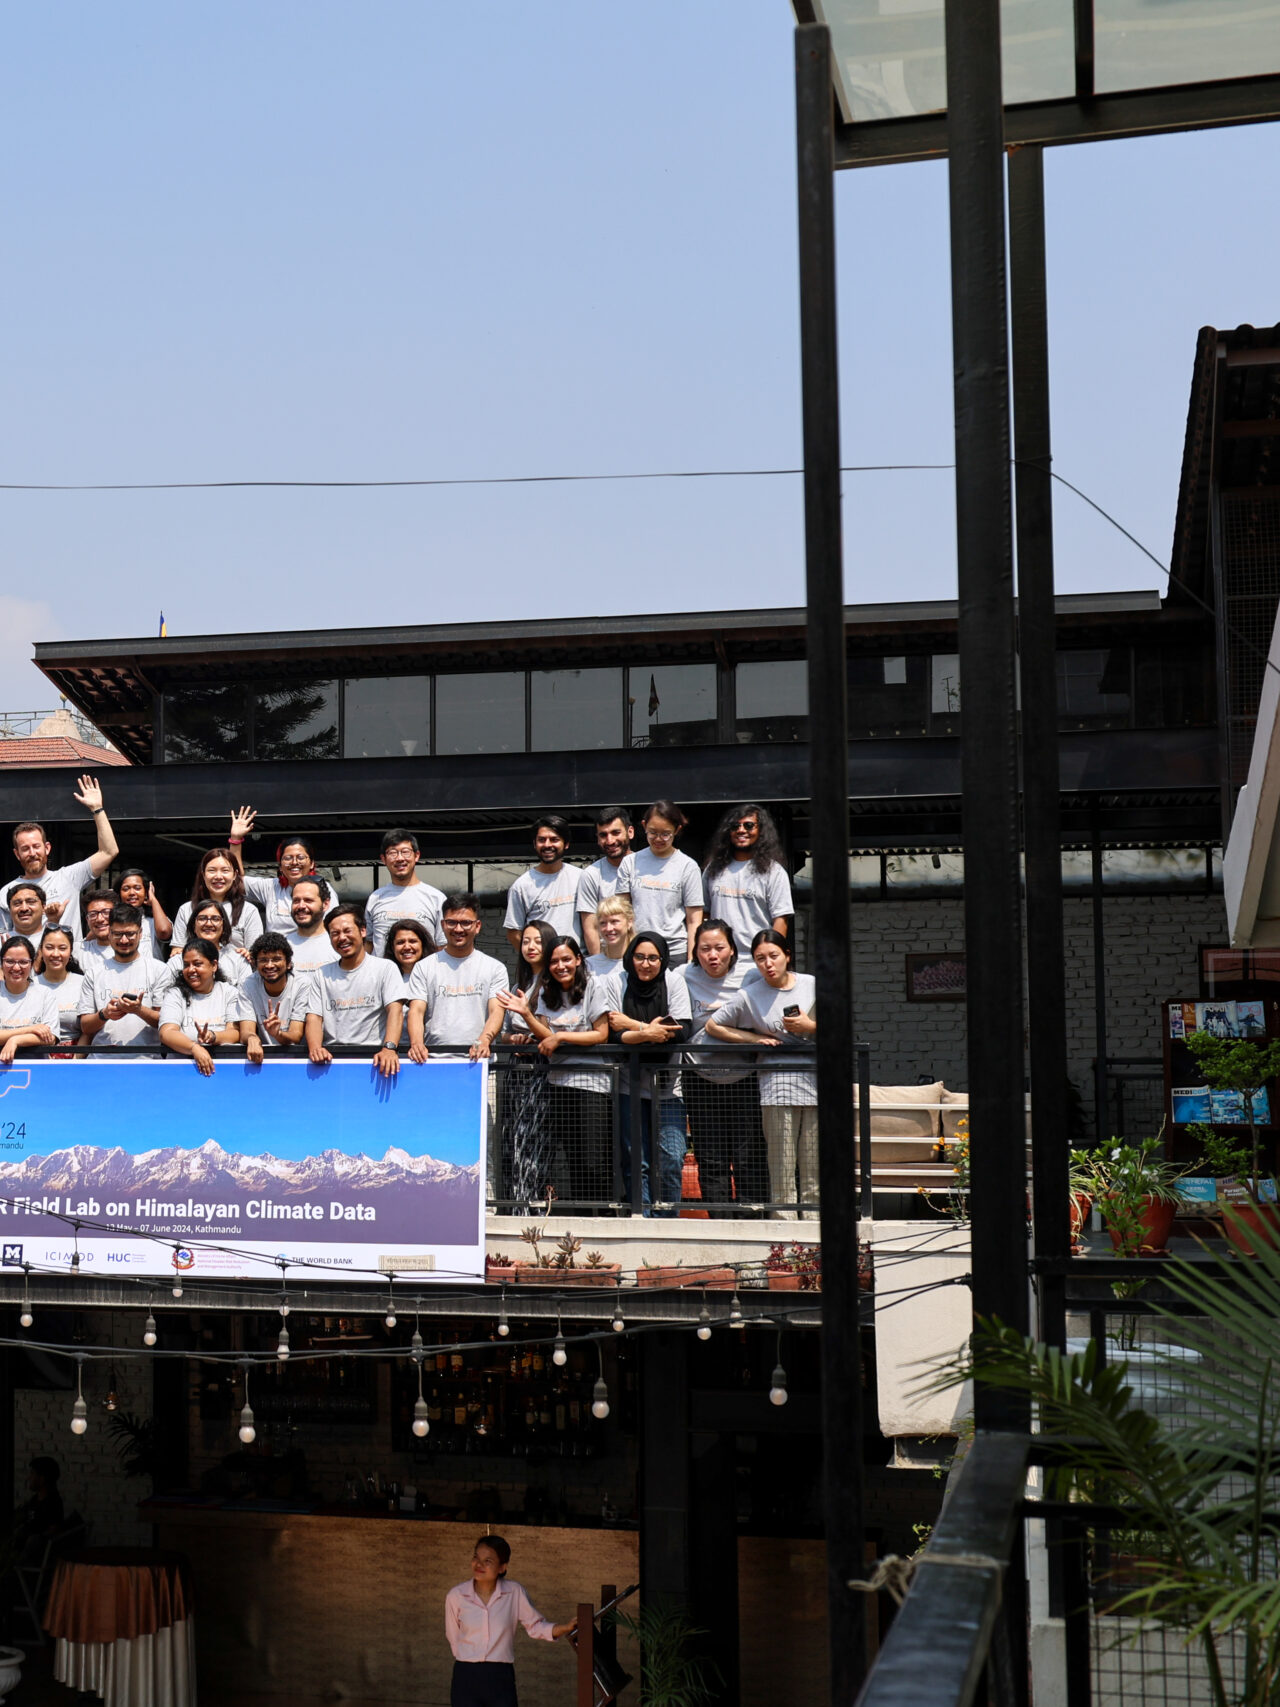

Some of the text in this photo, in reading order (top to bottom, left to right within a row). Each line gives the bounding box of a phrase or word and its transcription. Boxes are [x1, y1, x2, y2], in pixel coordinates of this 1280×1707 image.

[13, 1196, 60, 1216] Field
[65, 1197, 101, 1216] Lab
[105, 1201, 130, 1217] on
[135, 1198, 240, 1222] Himalayan
[245, 1199, 324, 1220] Climate
[329, 1201, 376, 1221] Data
[140, 1224, 150, 1233] 07
[151, 1224, 171, 1233] June
[172, 1224, 194, 1234] 2024,
[195, 1224, 242, 1234] Kathmandu
[107, 1252, 132, 1263] HUC
[292, 1256, 353, 1265] THE WORLD BANK
